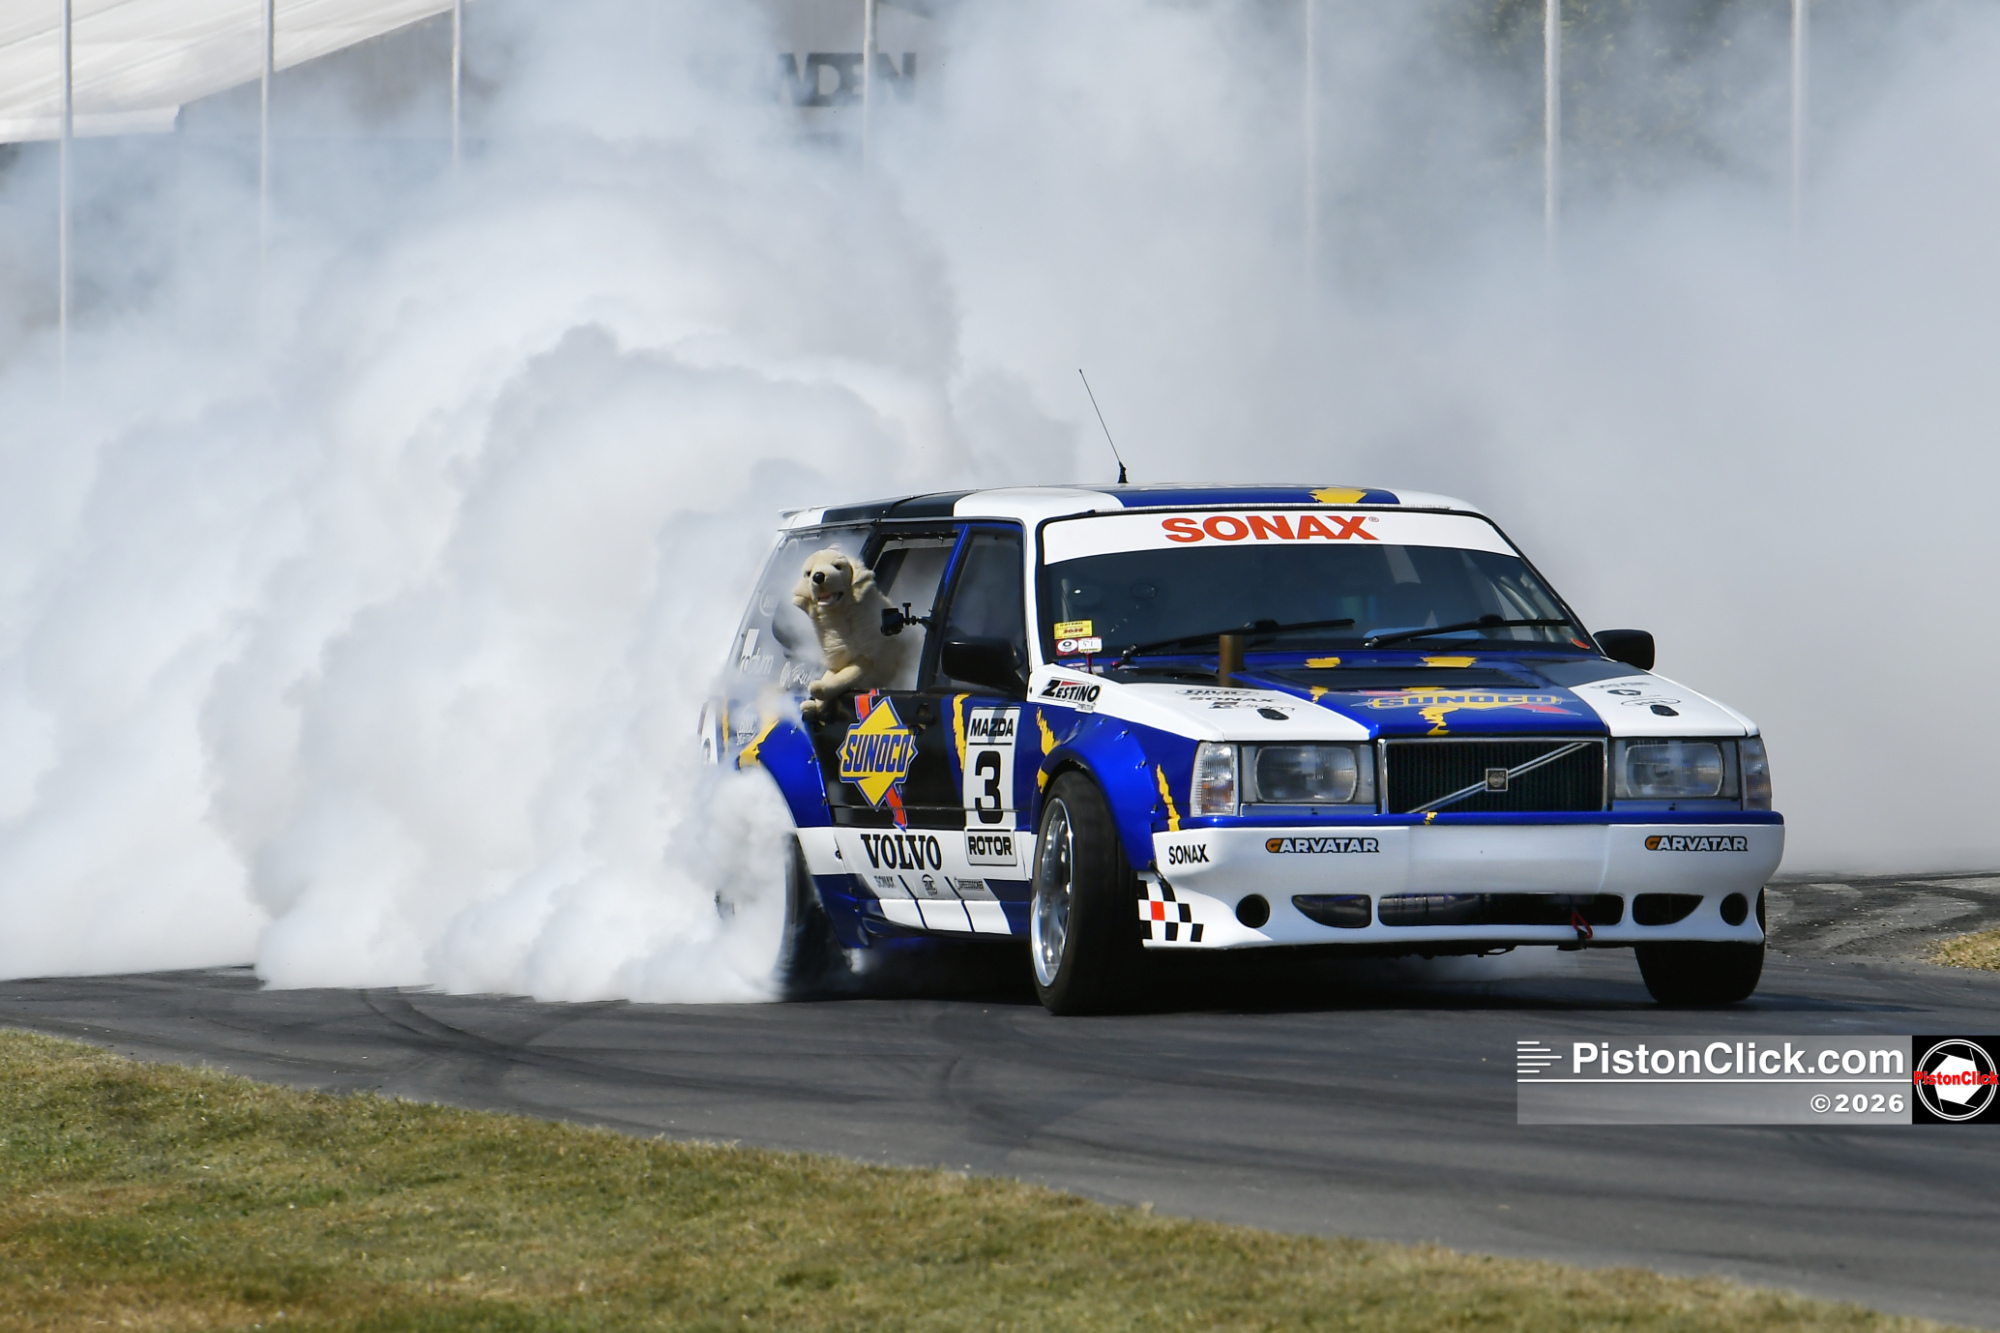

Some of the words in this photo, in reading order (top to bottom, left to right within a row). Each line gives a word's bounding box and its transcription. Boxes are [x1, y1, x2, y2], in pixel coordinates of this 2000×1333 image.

[1041, 679, 1102, 703] ZESTINO
[1377, 695, 1551, 707] SUNOCO
[970, 717, 1014, 738] MAZDA
[842, 733, 912, 773] SUNOCO
[974, 750, 1002, 824] 3
[860, 833, 942, 871] VOLVO
[968, 836, 1013, 856] ROTOR
[1168, 844, 1210, 865] SONAX
